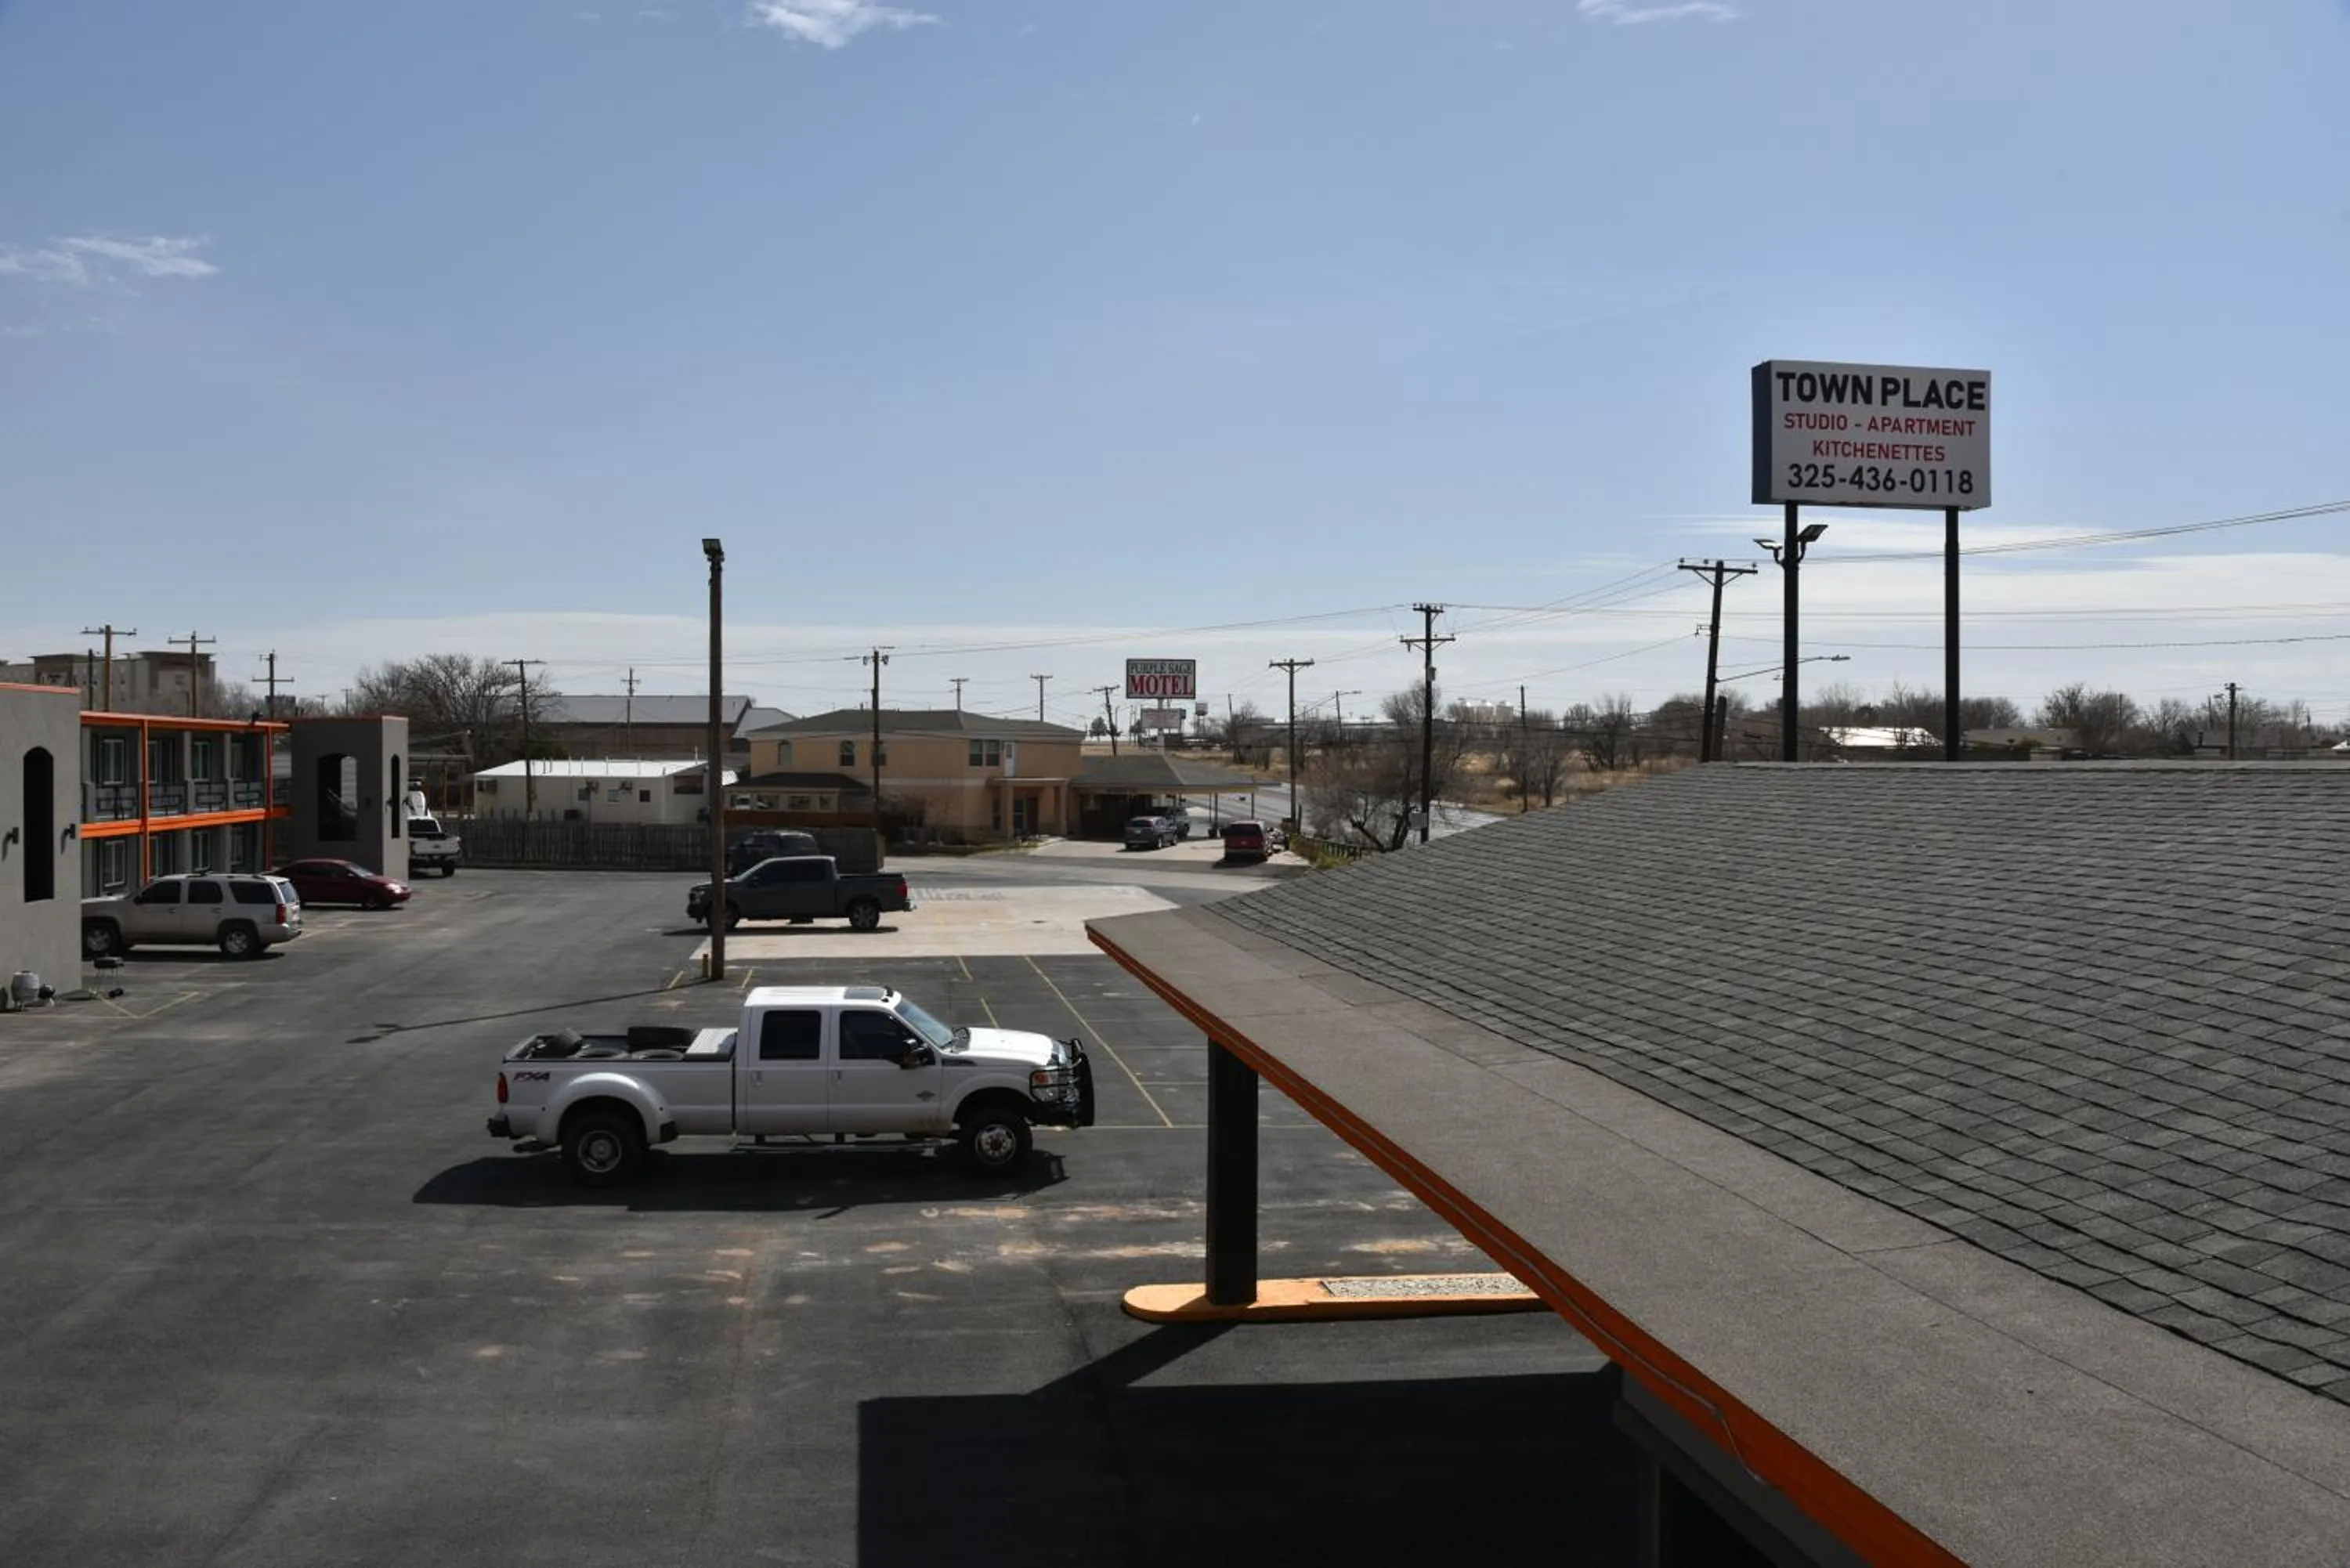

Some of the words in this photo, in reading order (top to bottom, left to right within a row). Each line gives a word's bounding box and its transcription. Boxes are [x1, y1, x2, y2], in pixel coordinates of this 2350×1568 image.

[1776, 372, 1873, 405] TOWN
[1882, 377, 1986, 410] PLACE
[1784, 413, 1848, 430] STUDIO
[1867, 416, 1976, 436] APARTMENT
[1813, 439, 1945, 461] KITCHENETTES
[1788, 463, 1973, 494] 325-436-0118
[1129, 675, 1193, 695] MOTEL
